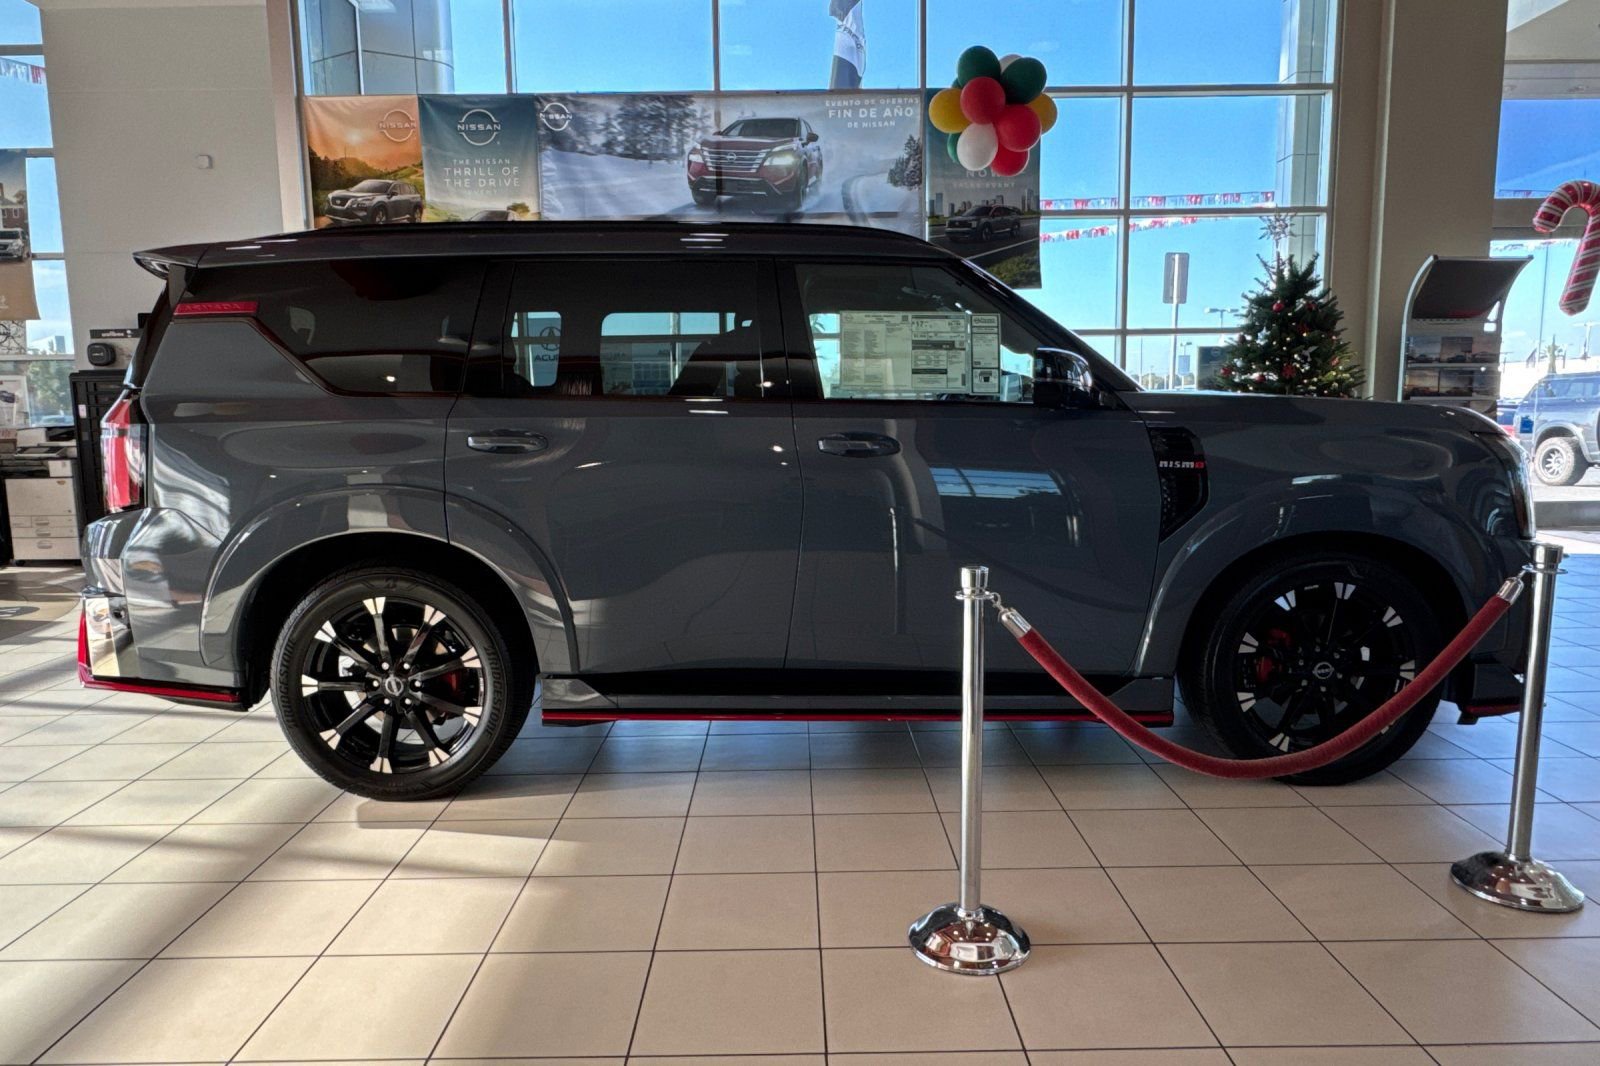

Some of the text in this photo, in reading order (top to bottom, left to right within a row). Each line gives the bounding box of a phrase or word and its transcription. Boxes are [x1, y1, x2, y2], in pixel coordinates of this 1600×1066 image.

[825, 99, 861, 107] EVENTO
[828, 105, 914, 118] FIN DE AÑO
[379, 121, 417, 129] NISSAN
[457, 123, 502, 131] NISSAN
[847, 120, 896, 129] DE NISSAN
[444, 166, 520, 176] THRILL OF
[444, 178, 521, 187] THE DRIVE
[483, 645, 504, 740] BRIDGESTONE
